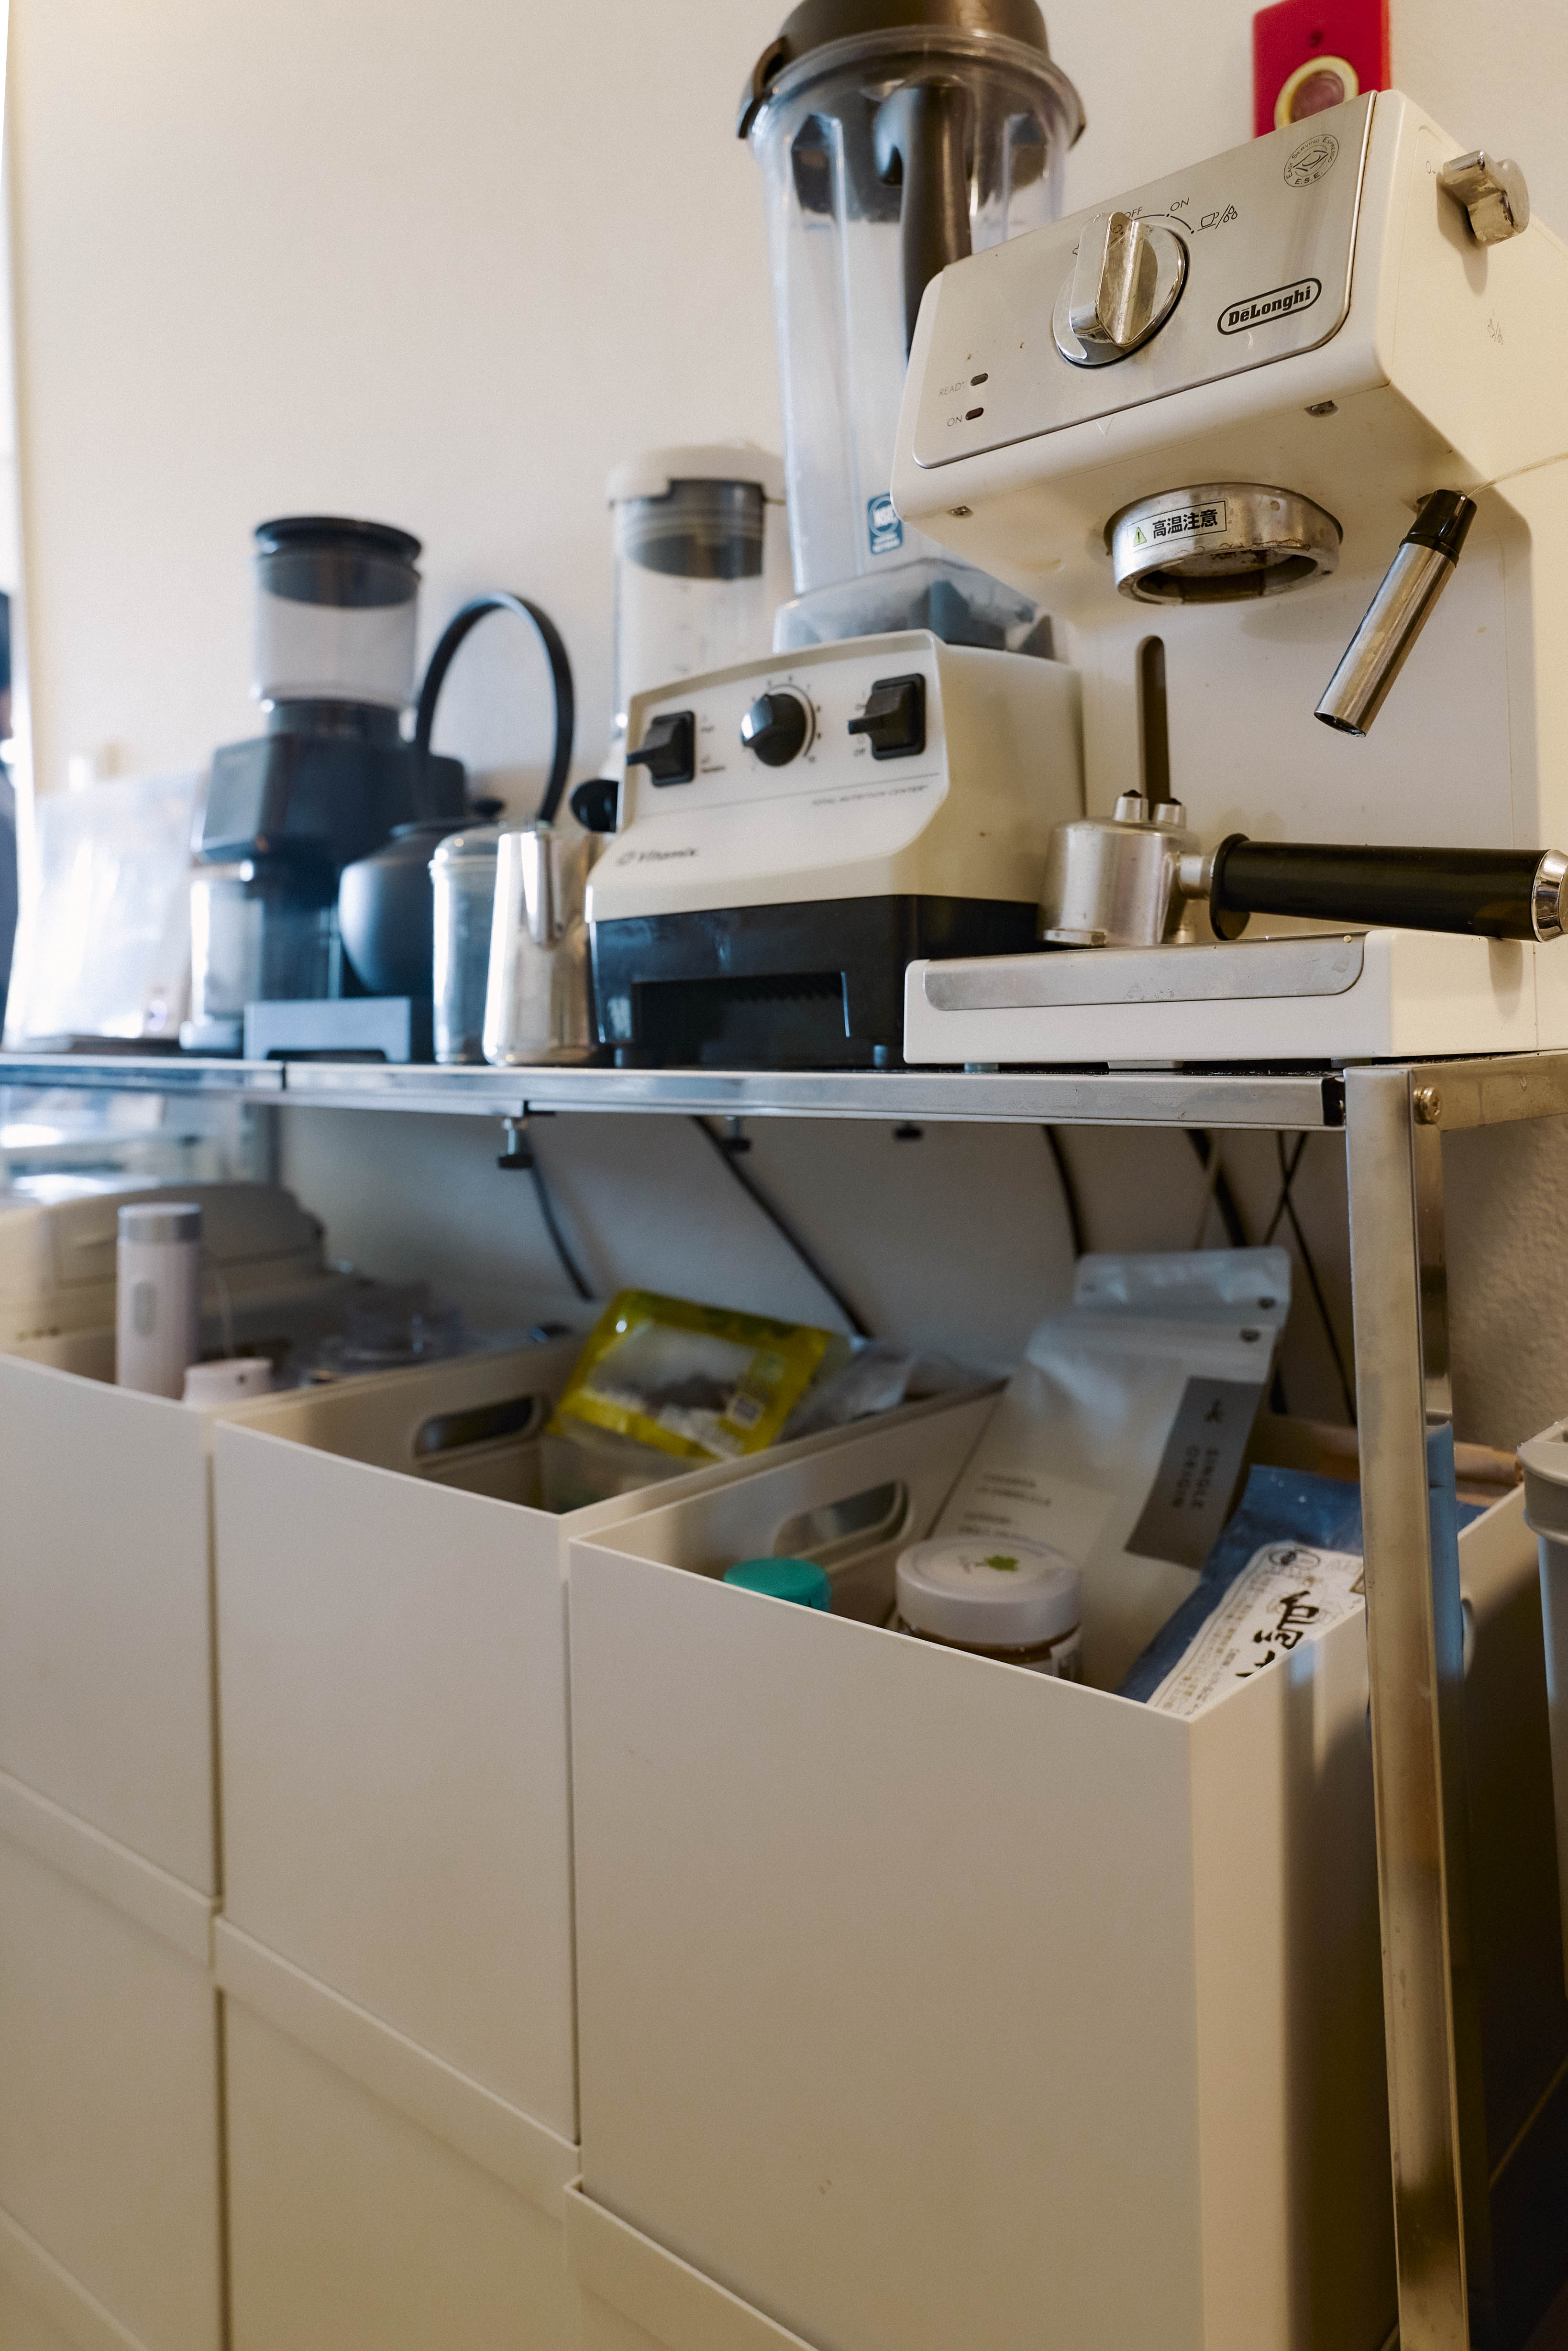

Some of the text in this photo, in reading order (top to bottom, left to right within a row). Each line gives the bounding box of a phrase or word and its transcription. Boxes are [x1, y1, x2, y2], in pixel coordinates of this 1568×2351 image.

[1292, 138, 1320, 159] SERVING
[1170, 197, 1190, 211] ON
[947, 415, 963, 427] ON
[1152, 508, 1218, 539] 高温注意
